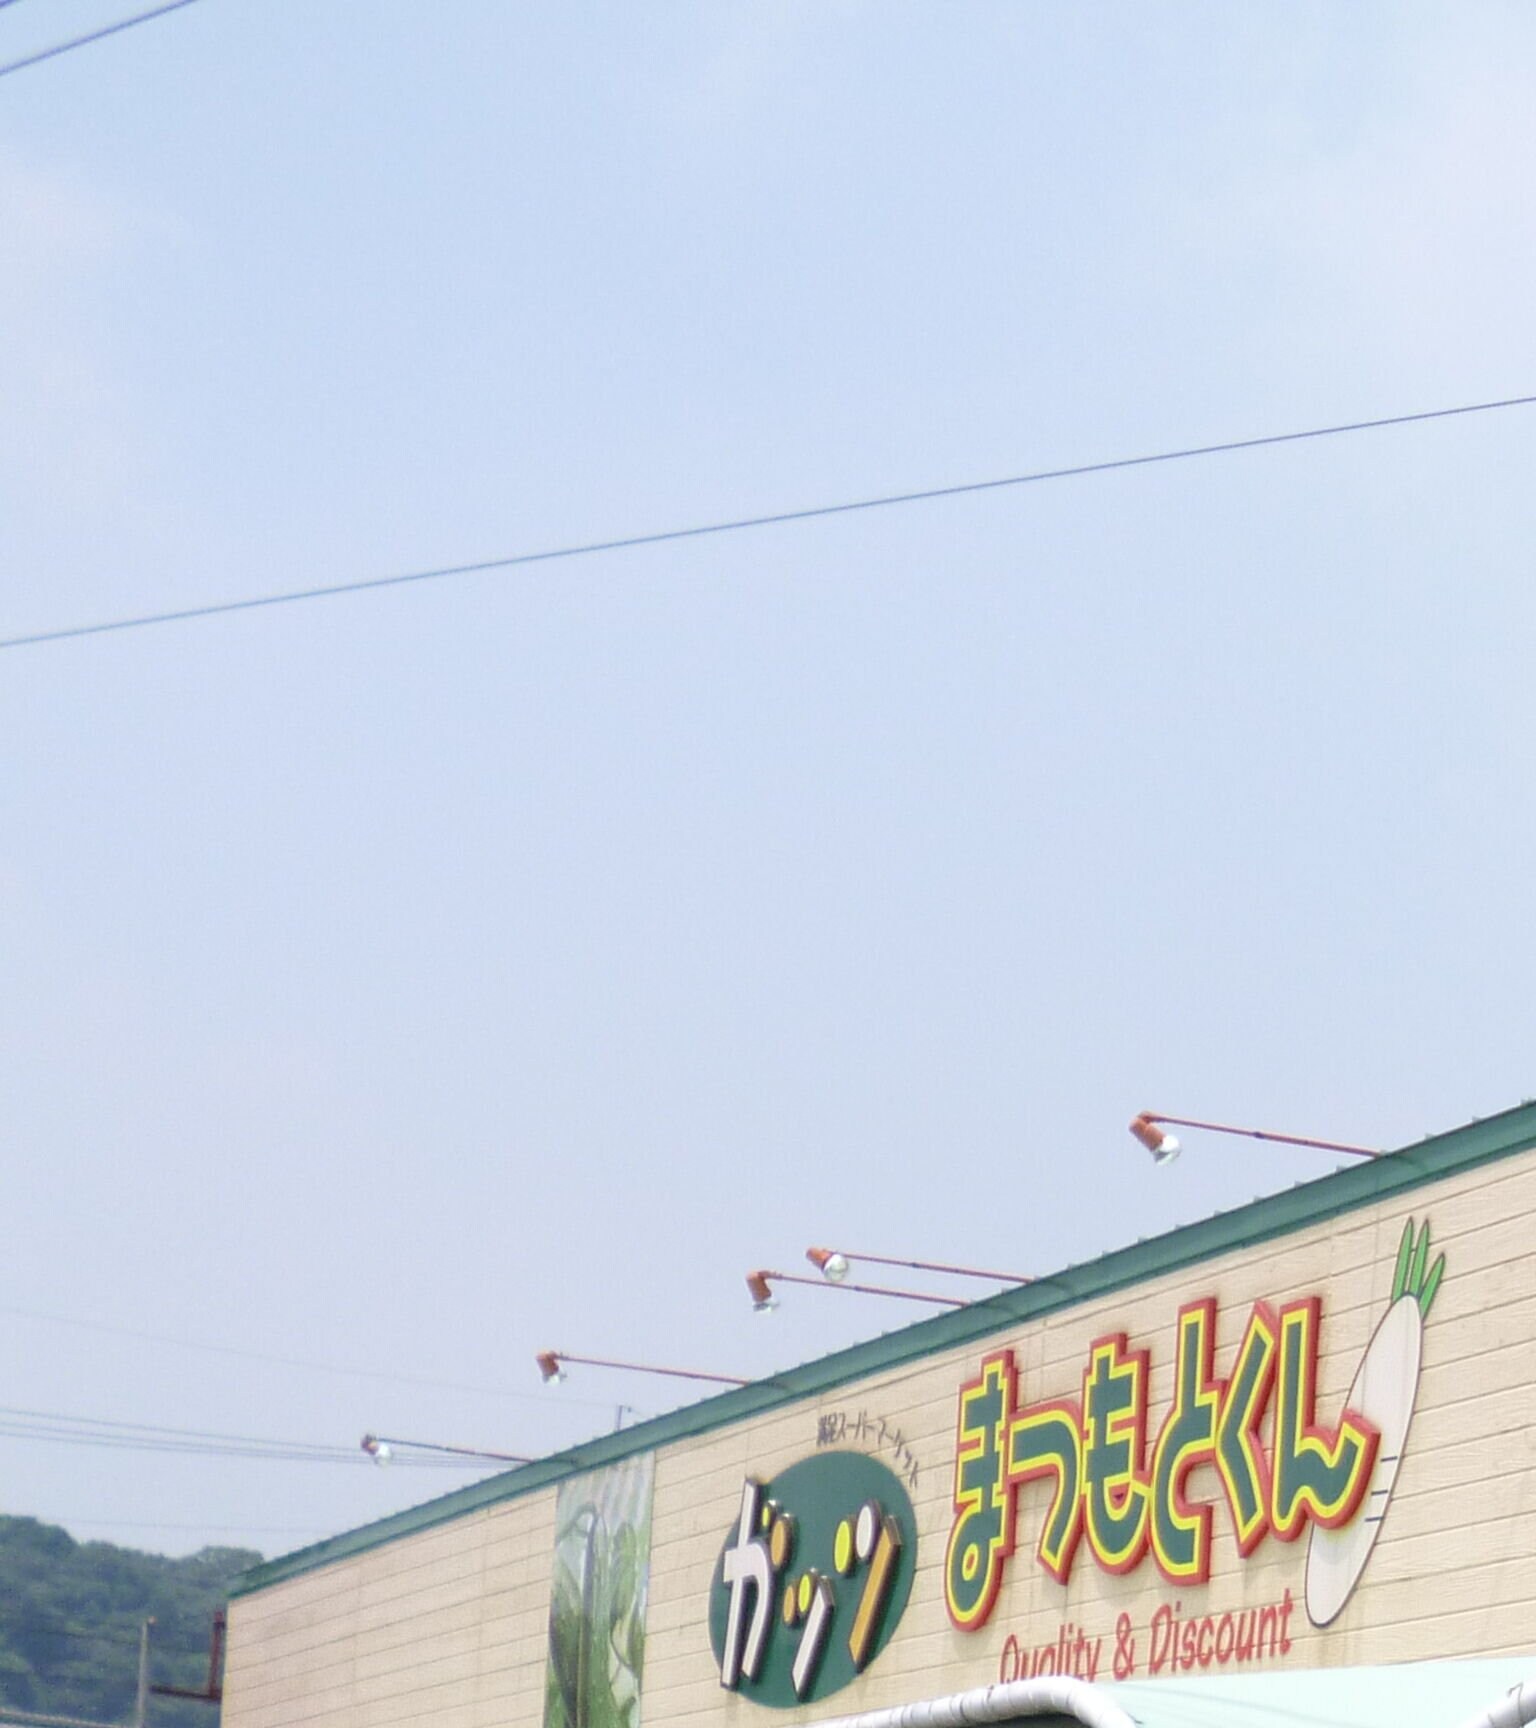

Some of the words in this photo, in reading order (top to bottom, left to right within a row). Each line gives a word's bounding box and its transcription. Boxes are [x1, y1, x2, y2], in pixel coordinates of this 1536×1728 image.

[943, 1296, 1383, 1633] まつもとくん
[1000, 1623, 1101, 1683] Quality
[1113, 1612, 1135, 1681] &
[1149, 1588, 1293, 1675] Discount
